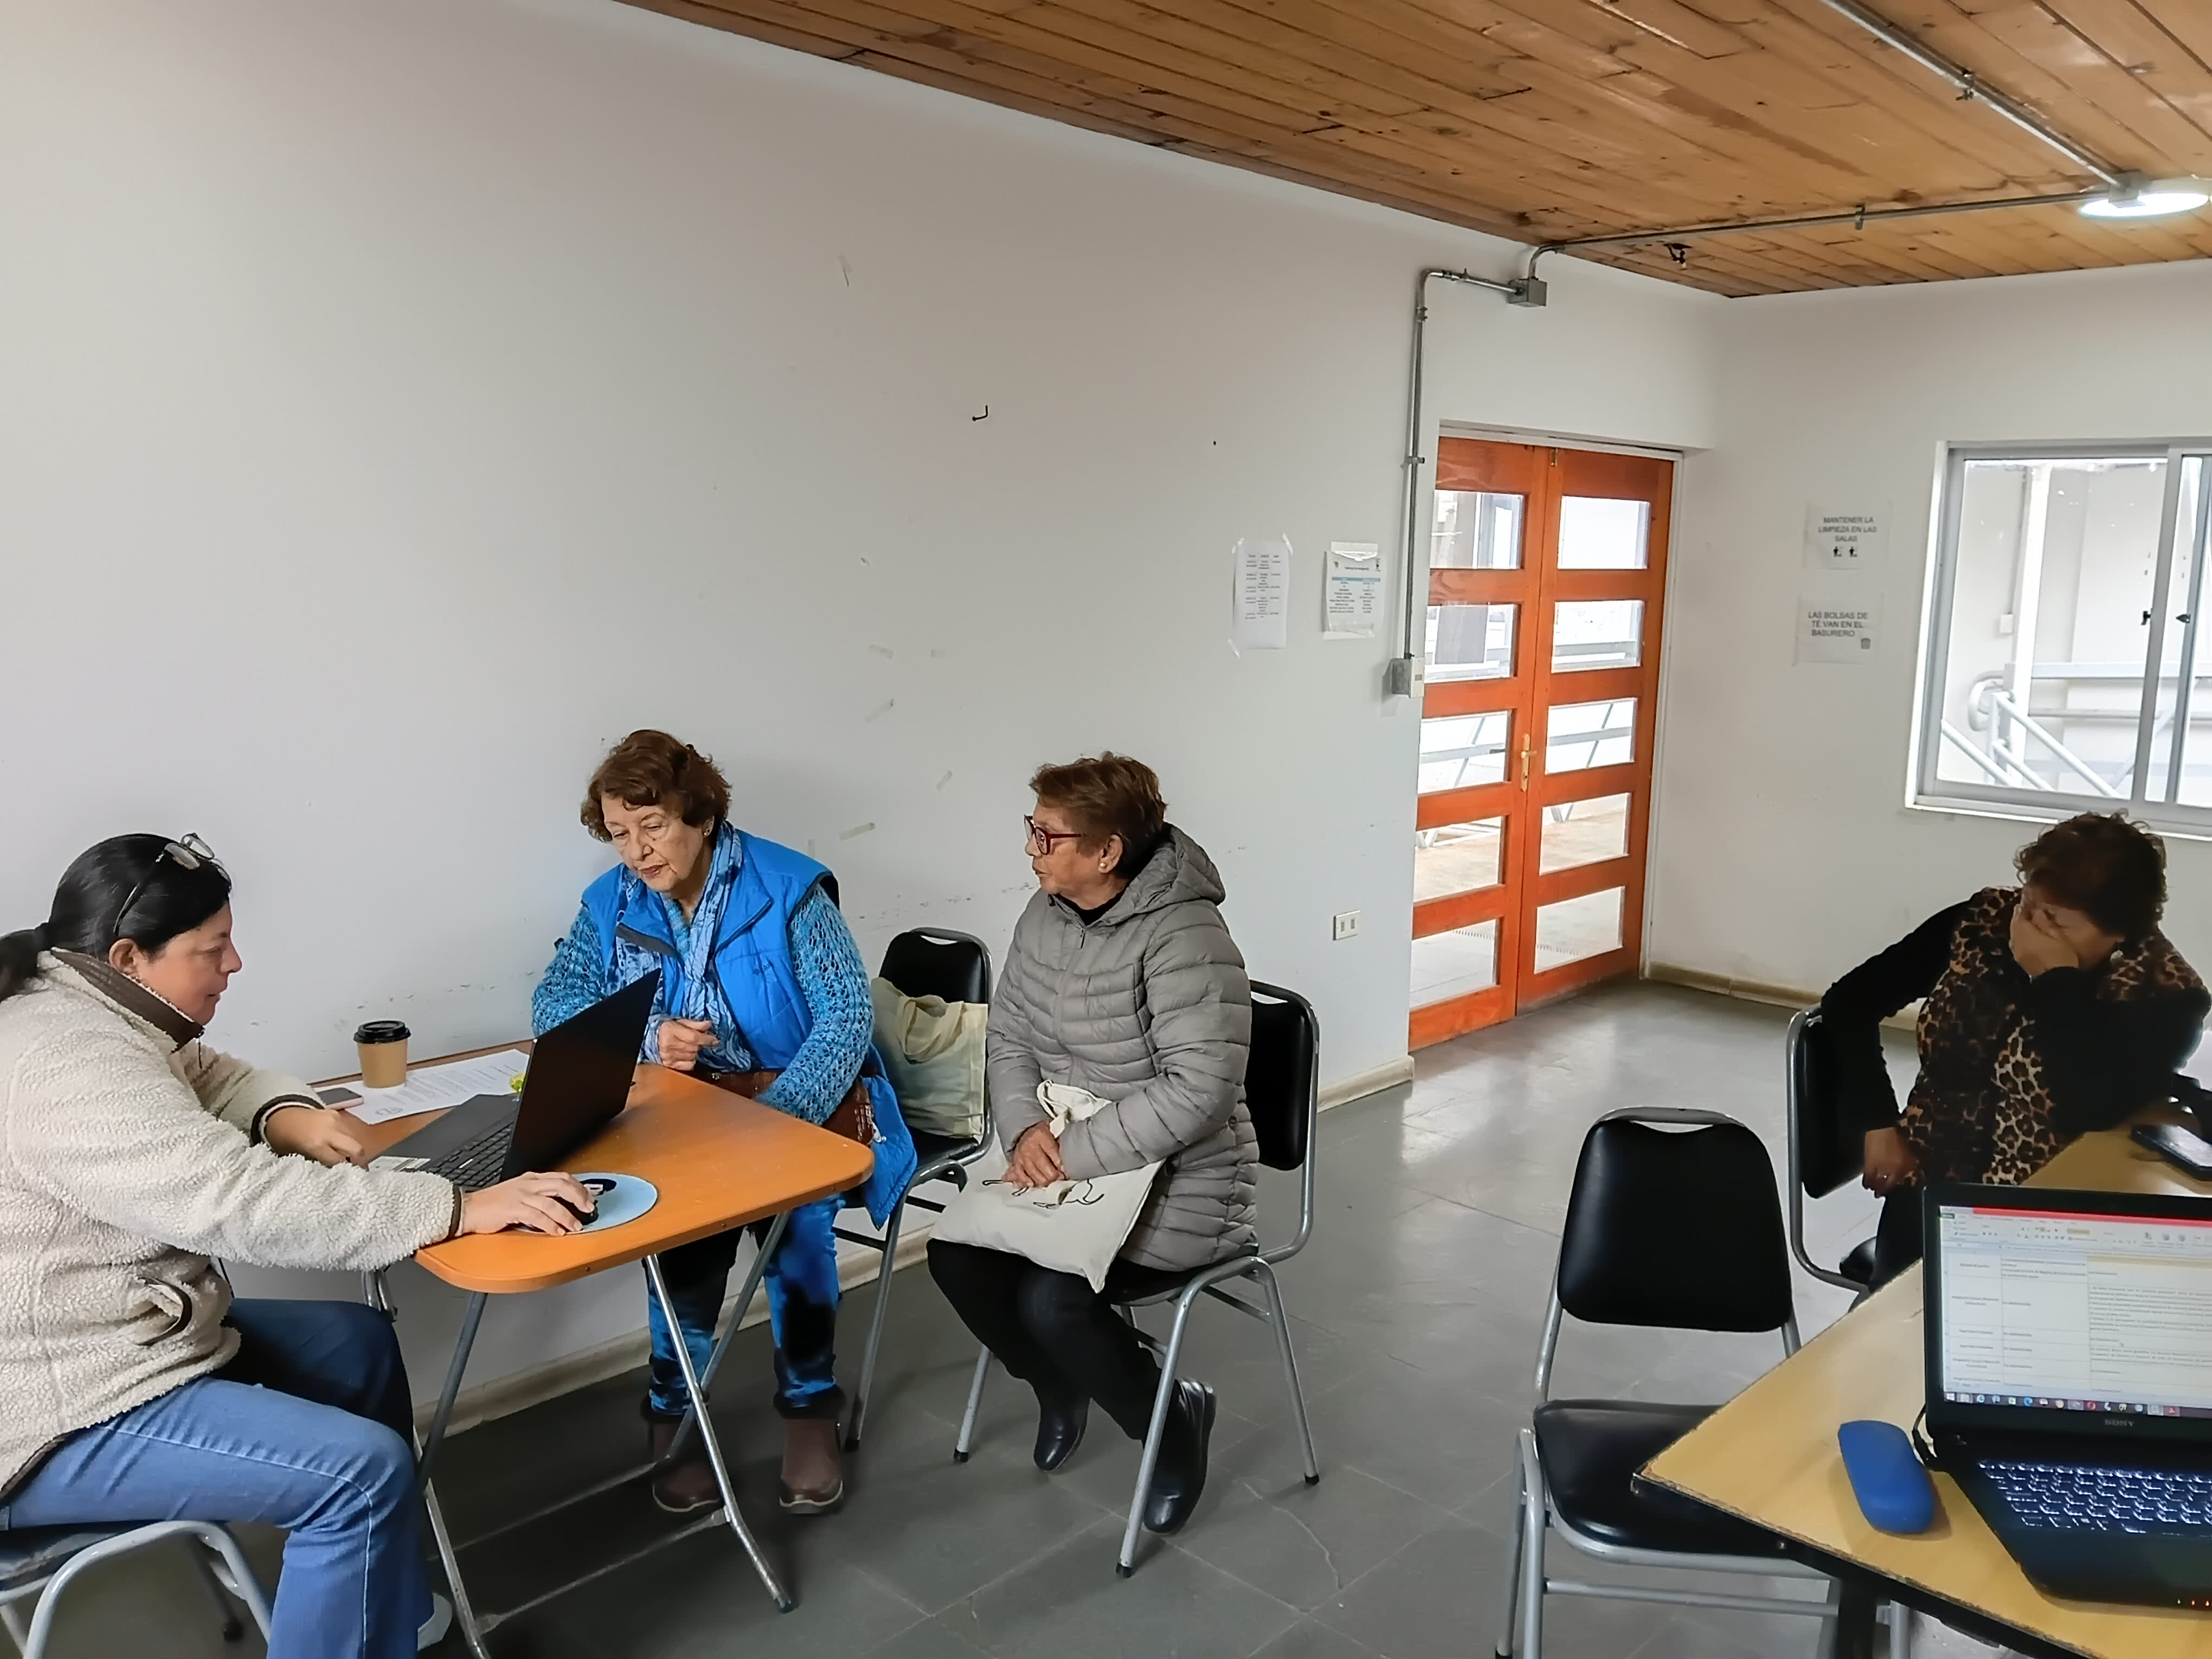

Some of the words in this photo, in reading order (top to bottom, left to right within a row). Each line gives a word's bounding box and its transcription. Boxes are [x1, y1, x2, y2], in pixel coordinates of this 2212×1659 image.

[1857, 612, 1869, 620] DE
[1811, 629, 1855, 637] BASURERO
[2105, 1419, 2134, 1427] SONY
